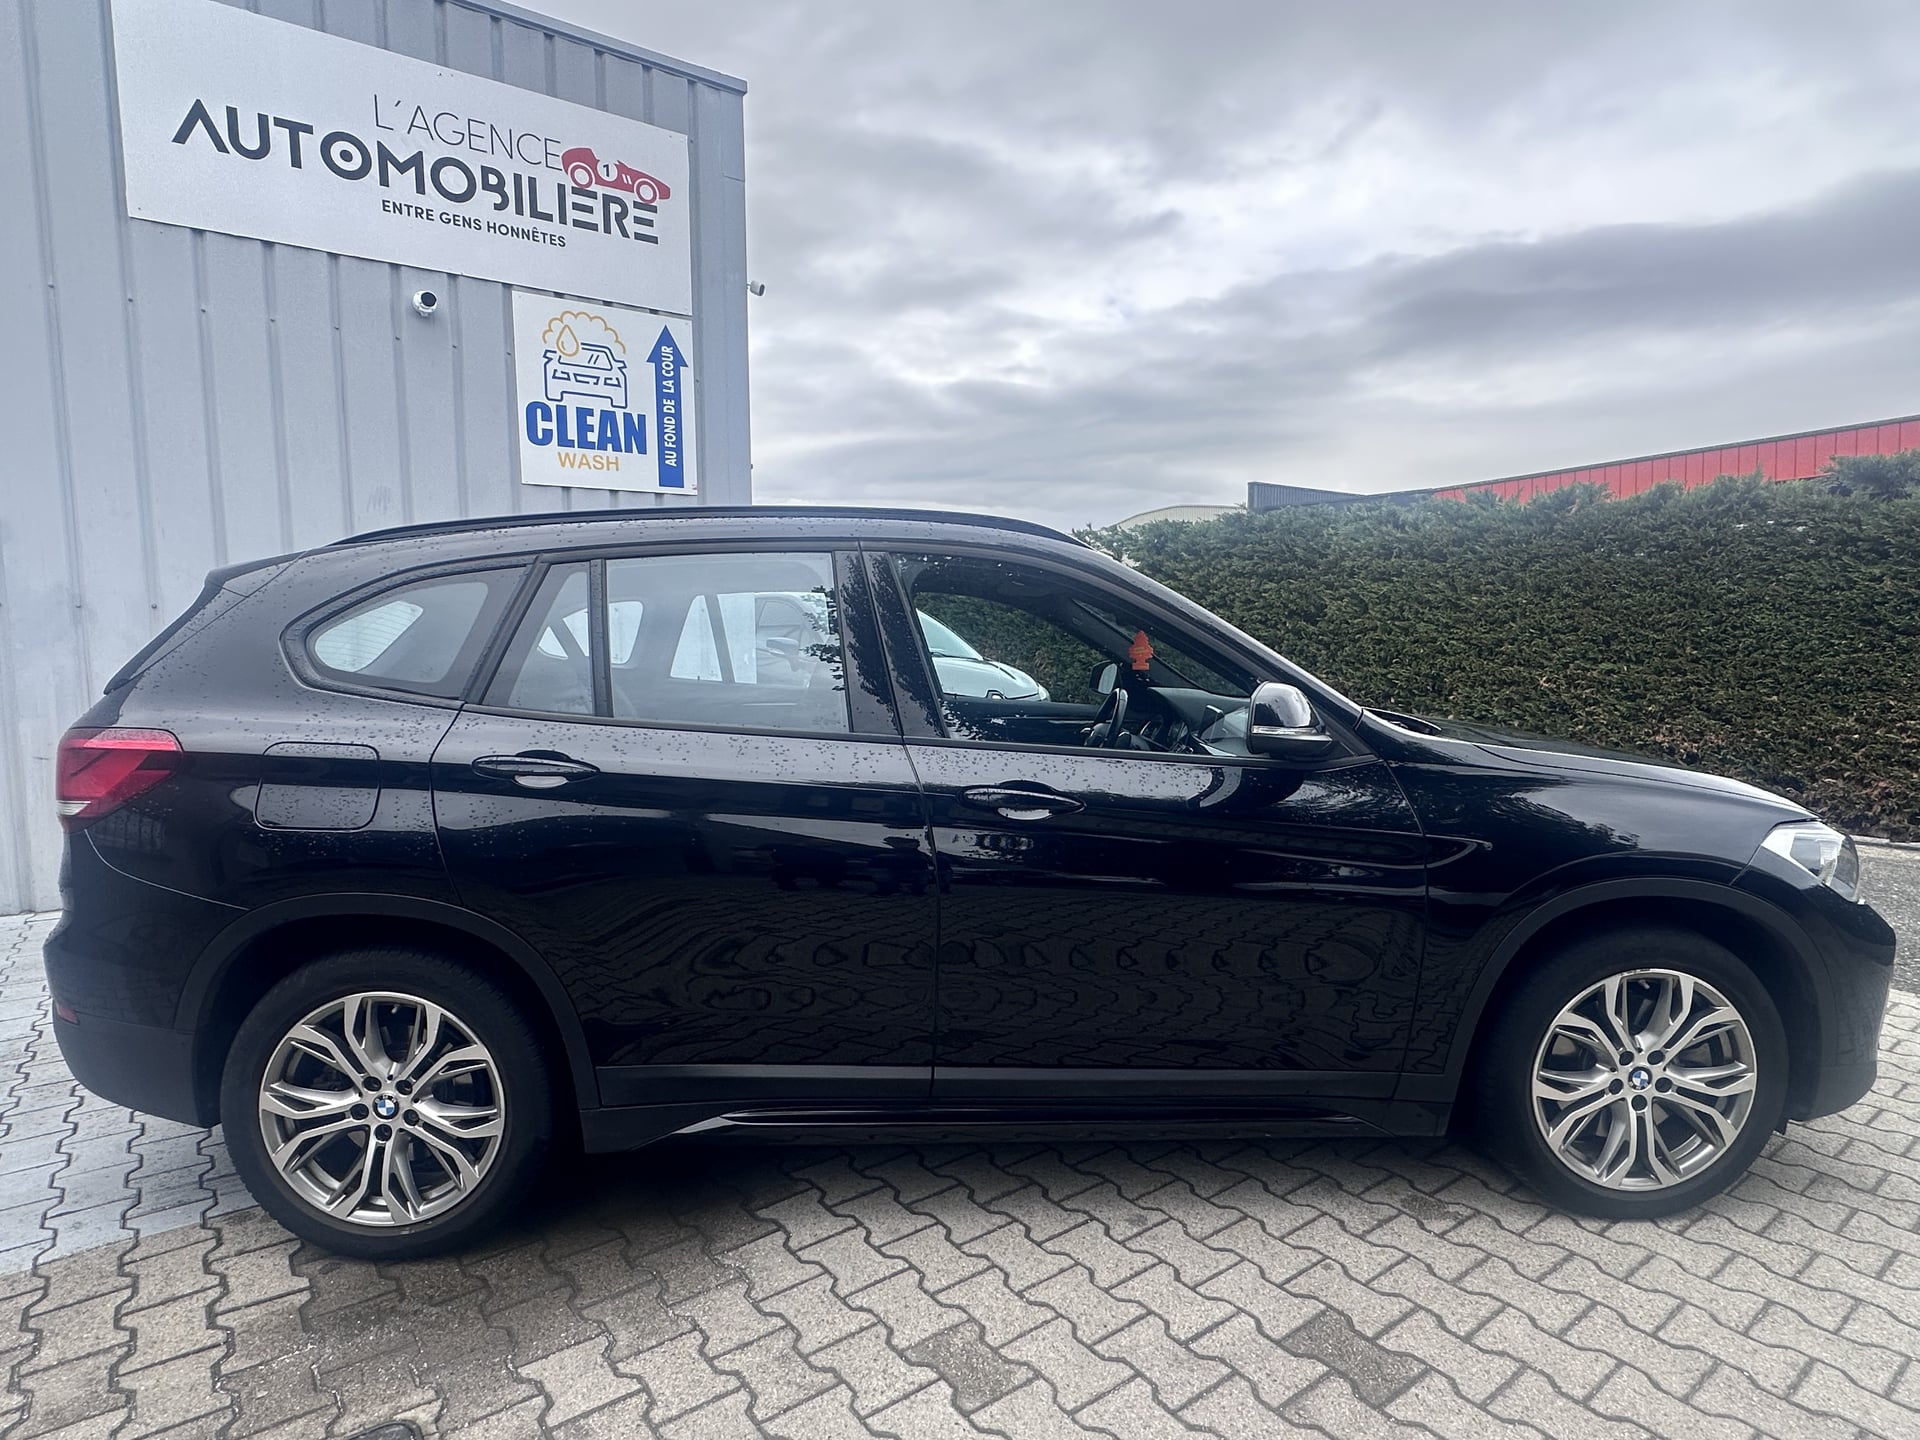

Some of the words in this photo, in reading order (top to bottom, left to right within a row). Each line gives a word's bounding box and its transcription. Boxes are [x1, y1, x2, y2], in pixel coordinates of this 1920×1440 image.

[602, 163, 610, 178] 1
[381, 199, 435, 222] ENTRE
[439, 212, 482, 231] GENS
[486, 220, 567, 247] HONNÊTES
[661, 345, 675, 377] COUR
[662, 380, 675, 394] LA
[664, 399, 676, 414] DE
[525, 401, 648, 455] CLEAN
[664, 416, 677, 449] FOND
[557, 452, 620, 472] WASH
[664, 452, 678, 467] AU
